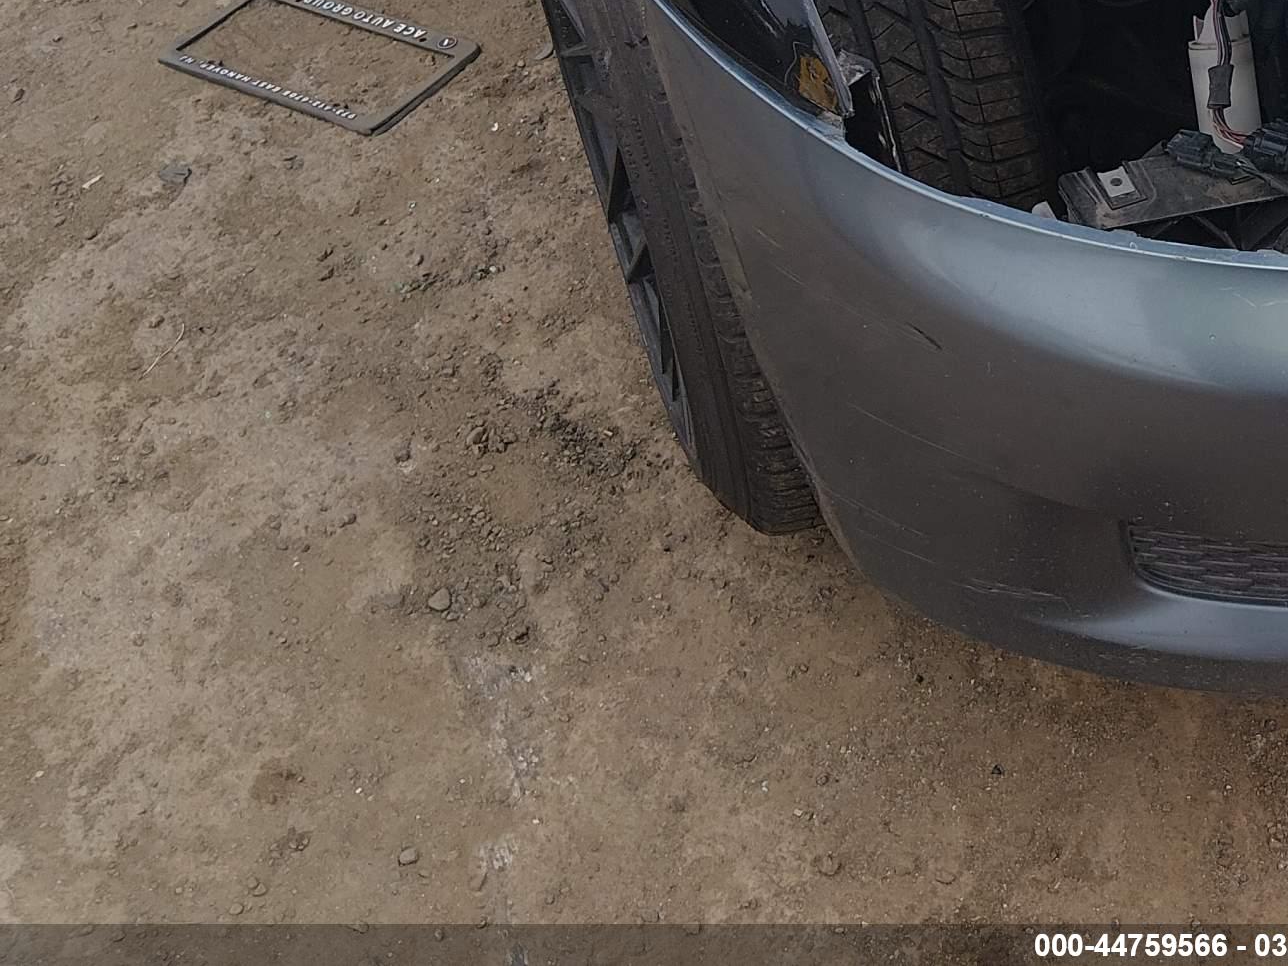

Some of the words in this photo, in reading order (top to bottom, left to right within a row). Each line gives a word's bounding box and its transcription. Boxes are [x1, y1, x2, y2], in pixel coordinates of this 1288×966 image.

[354, 10, 395, 29] AUTO
[393, 23, 427, 39] ACE
[251, 80, 282, 93] EAST
